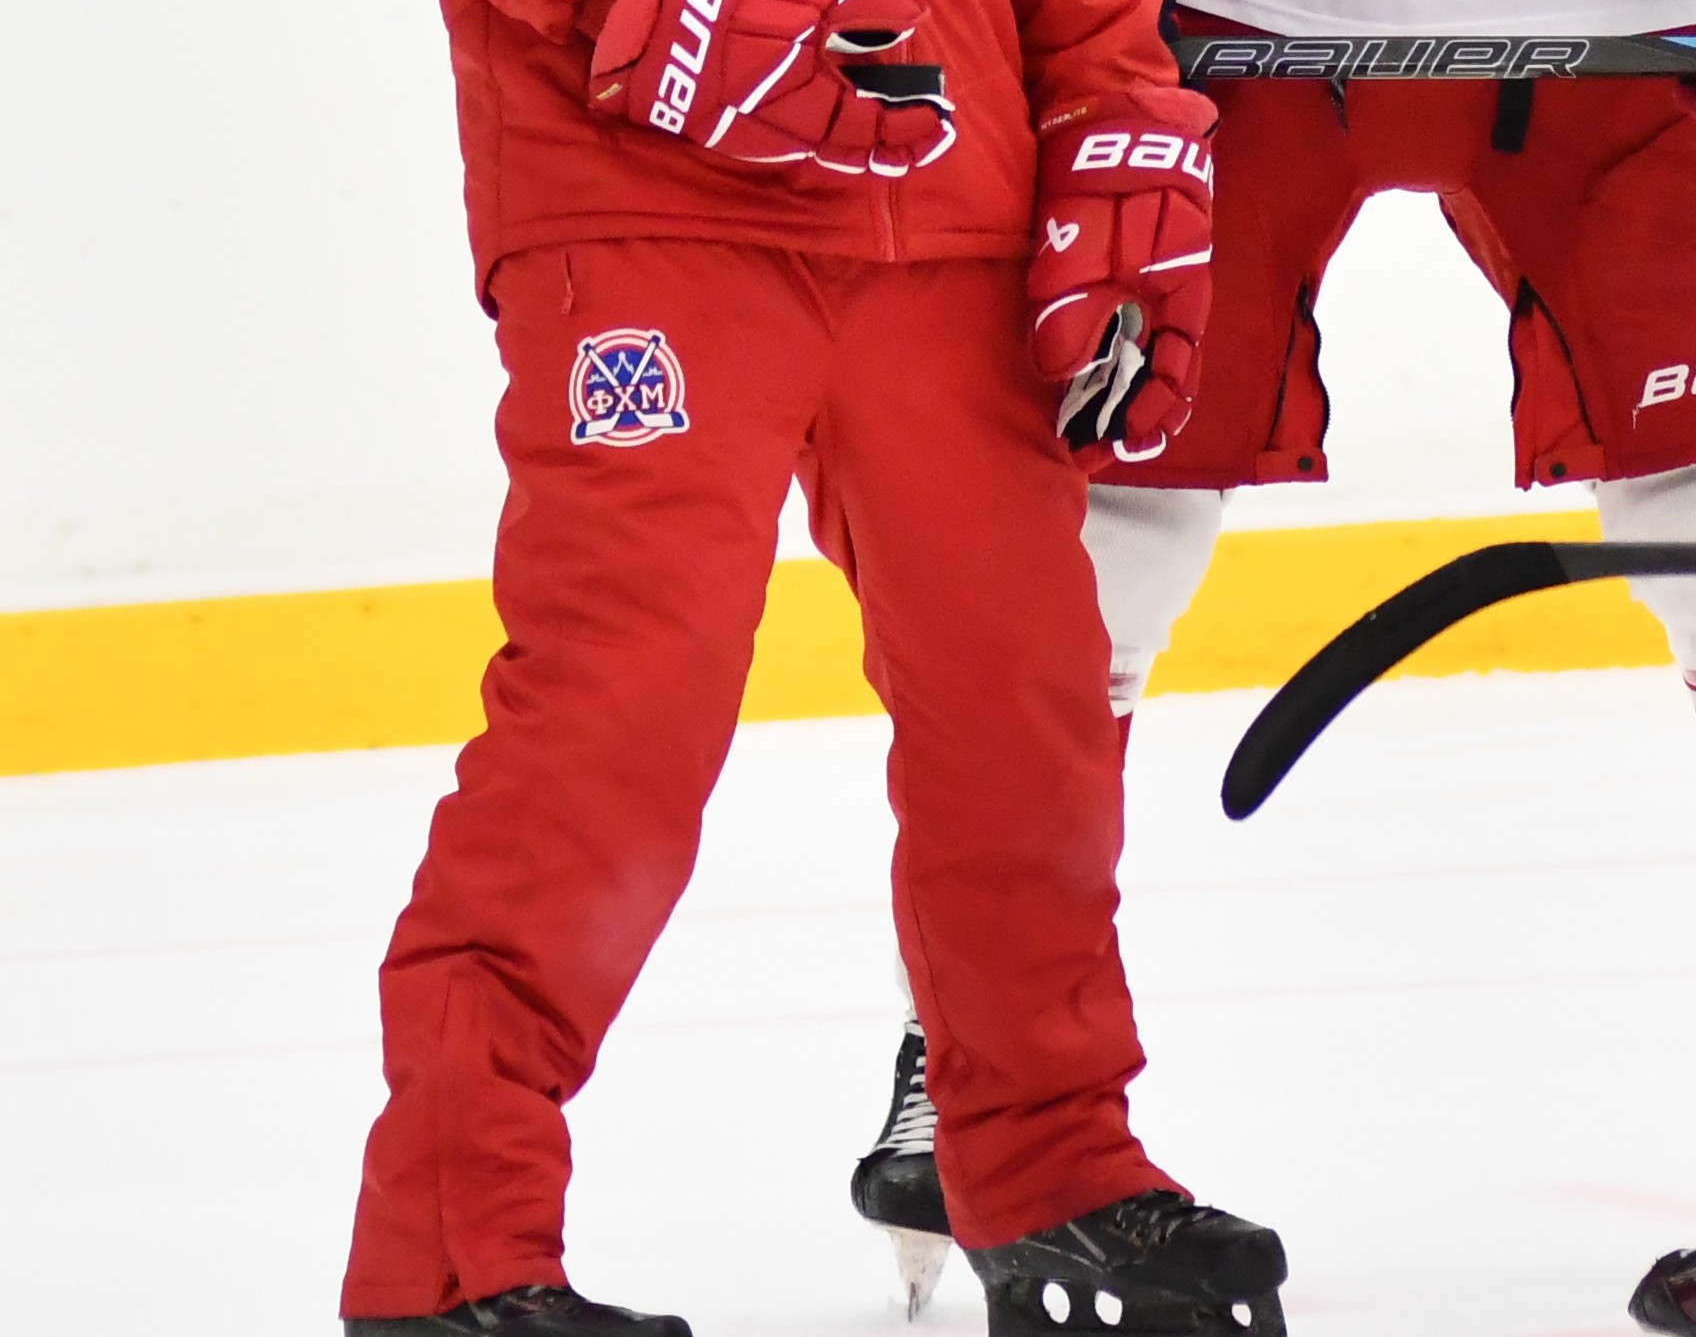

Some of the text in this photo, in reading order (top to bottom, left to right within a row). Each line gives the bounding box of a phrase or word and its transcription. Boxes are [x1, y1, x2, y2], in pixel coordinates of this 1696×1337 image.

[1187, 39, 1590, 79] BAUER
[1072, 133, 1213, 198] BAU
[586, 383, 665, 415] ФХМ
